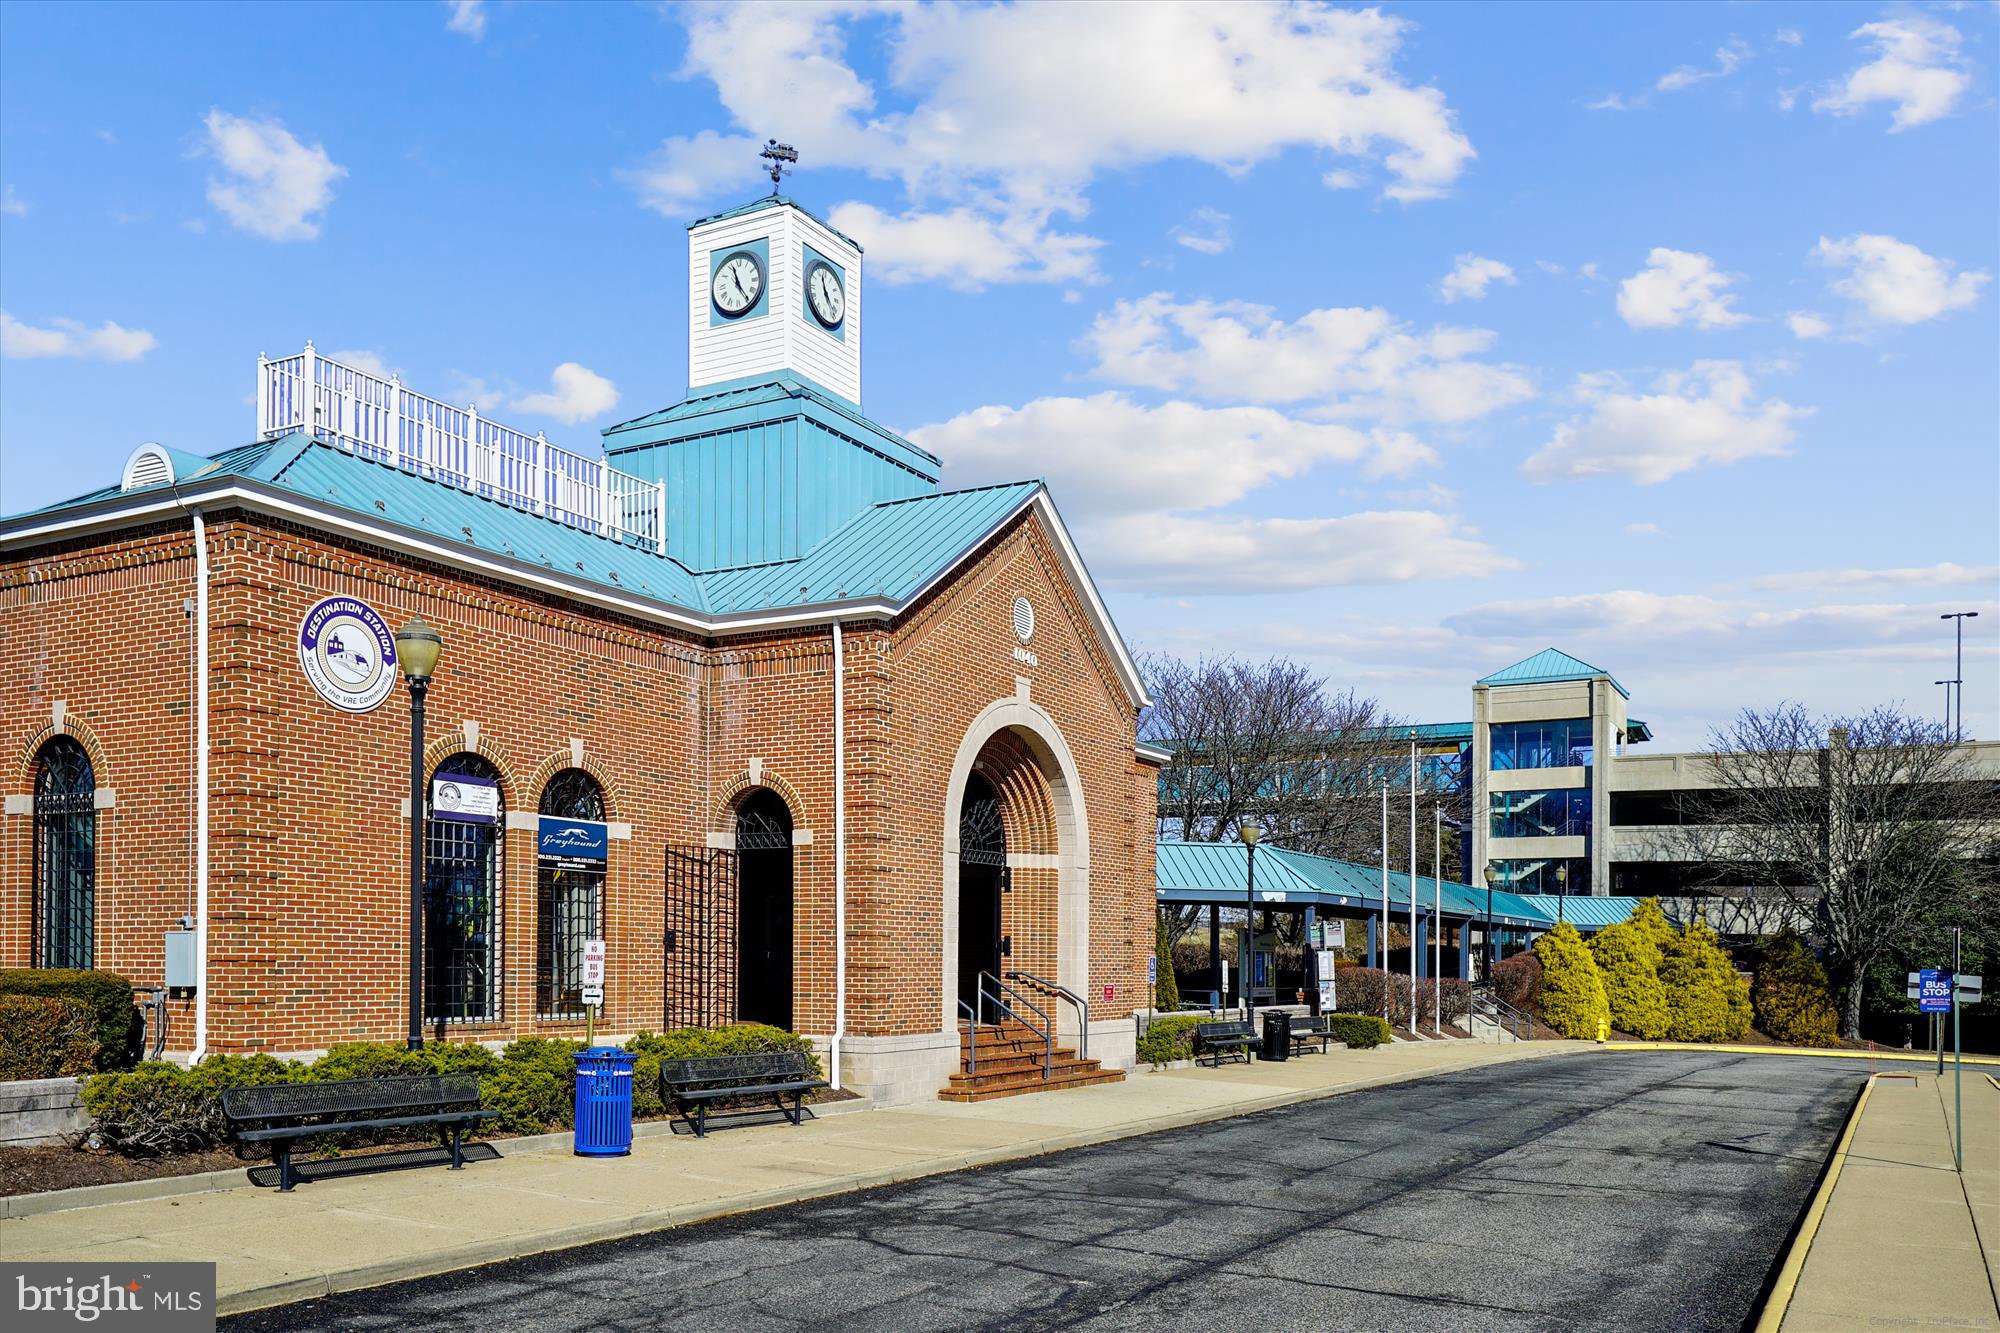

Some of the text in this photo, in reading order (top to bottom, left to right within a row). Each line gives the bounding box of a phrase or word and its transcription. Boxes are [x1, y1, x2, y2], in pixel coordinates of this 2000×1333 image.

[307, 601, 392, 656] DESTINATION STATION
[1013, 647, 1037, 666] 1040
[306, 656, 328, 693] Serving
[327, 689, 341, 701] the
[359, 672, 392, 704] Community
[542, 834, 601, 847] Greyhound
[585, 954, 603, 962] PARKING
[1925, 980, 1947, 988] BUS
[1922, 988, 1950, 996] STOP
